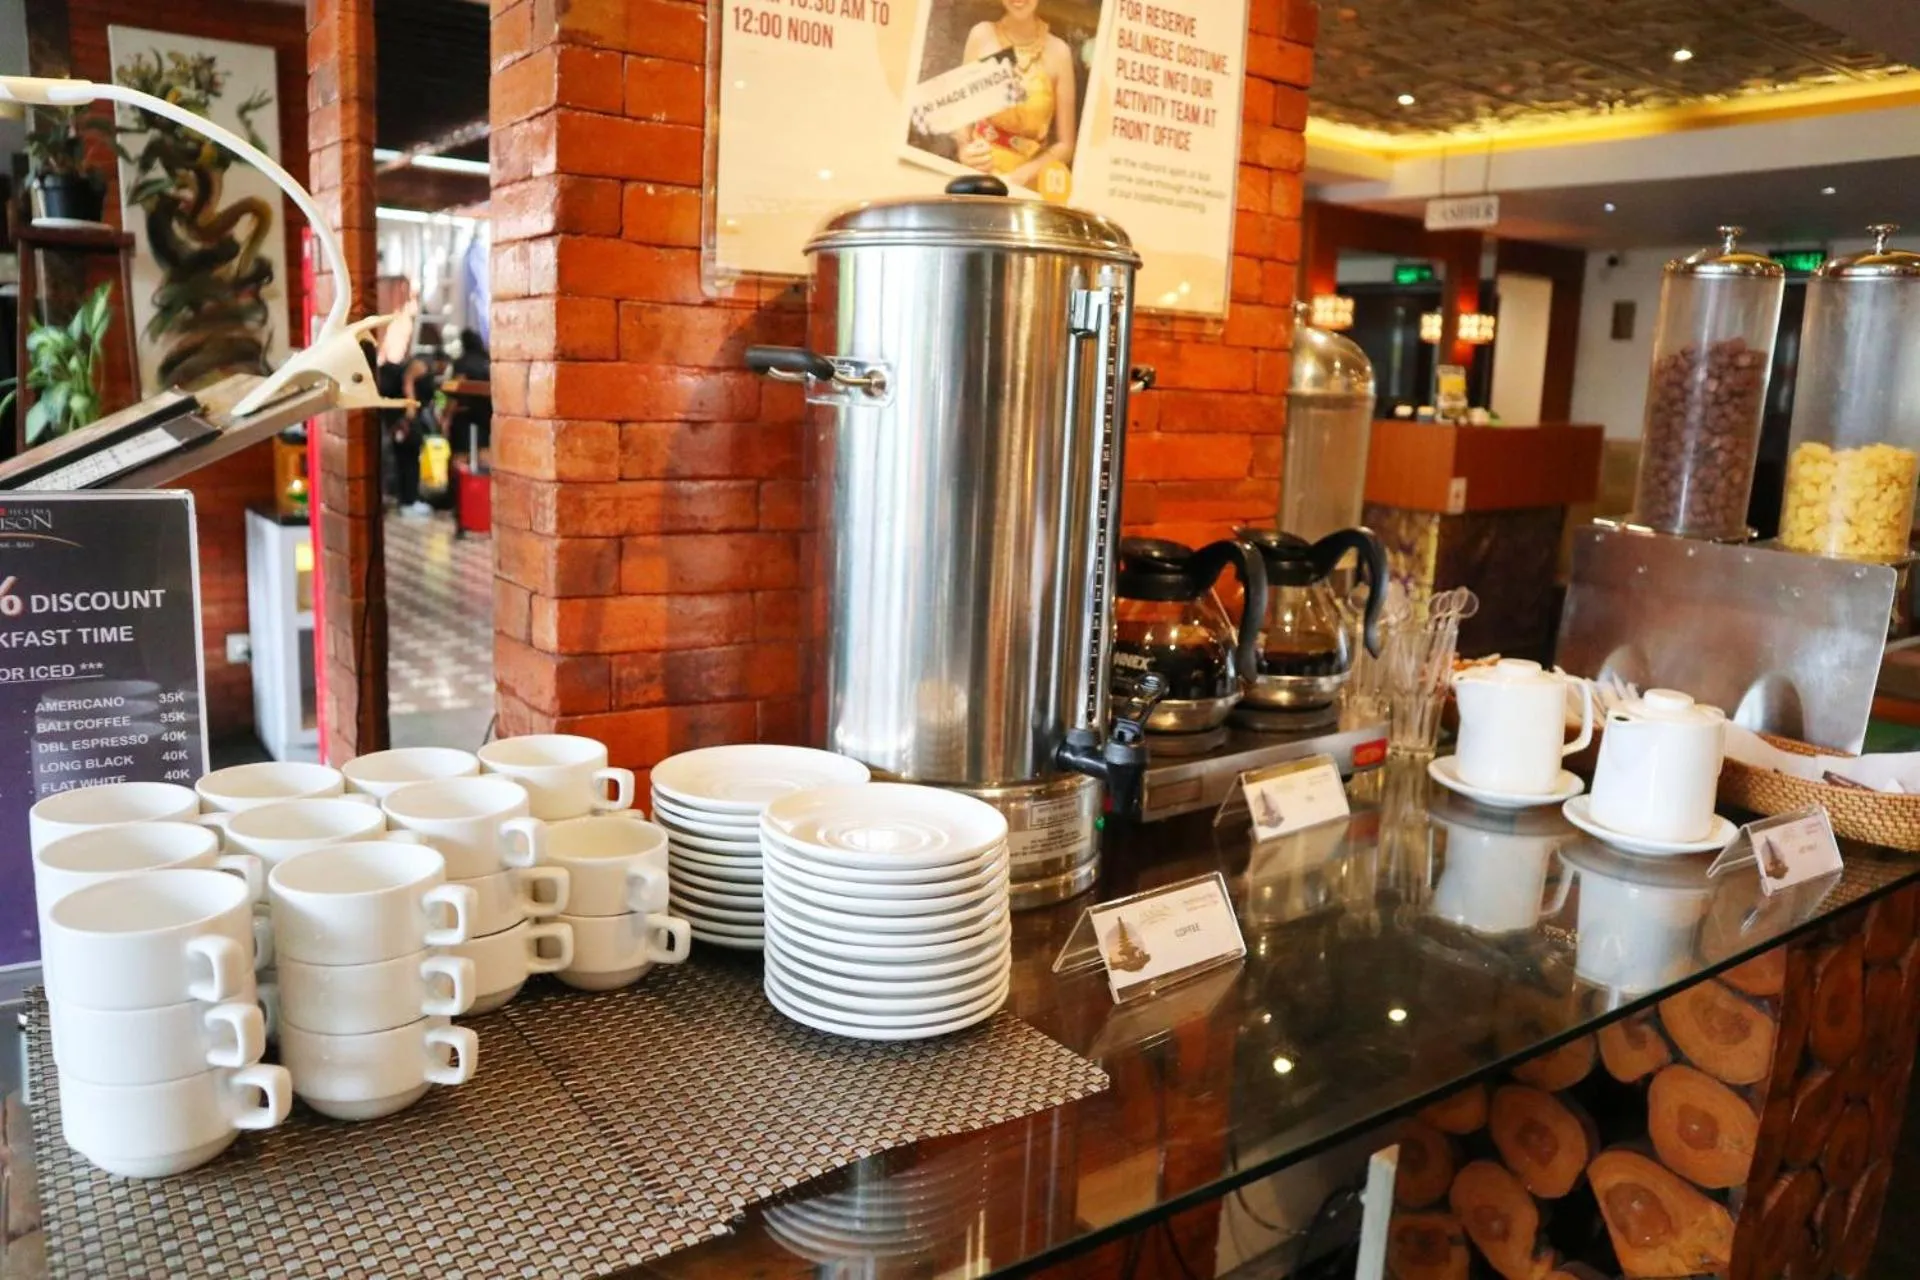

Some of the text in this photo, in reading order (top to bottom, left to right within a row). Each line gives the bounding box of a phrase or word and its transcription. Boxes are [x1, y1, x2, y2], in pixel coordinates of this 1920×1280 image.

[870, 0, 890, 26] TO
[1119, 0, 1197, 38] FOR RESERVE
[733, 6, 834, 49] 12:00 NOON
[1117, 28, 1175, 61] BALINESE
[1116, 58, 1214, 99] PLEASE INFO OUR
[1114, 88, 1217, 128] ACTIVITY TEAM AT
[1112, 117, 1193, 152] FRONT OFFICE
[31, 590, 166, 613] DISCOUNT
[76, 626, 135, 644] TIME
[30, 664, 75, 679] ICED
[35, 692, 185, 713] AMERICANO 35K
[36, 712, 186, 734] BALI COFFEE 35K
[38, 731, 187, 754] DBL ESPRESSO 40K
[40, 750, 189, 774] LONG BLACK 40K
[42, 780, 78, 794] FLAT
[164, 769, 191, 781] 40K
